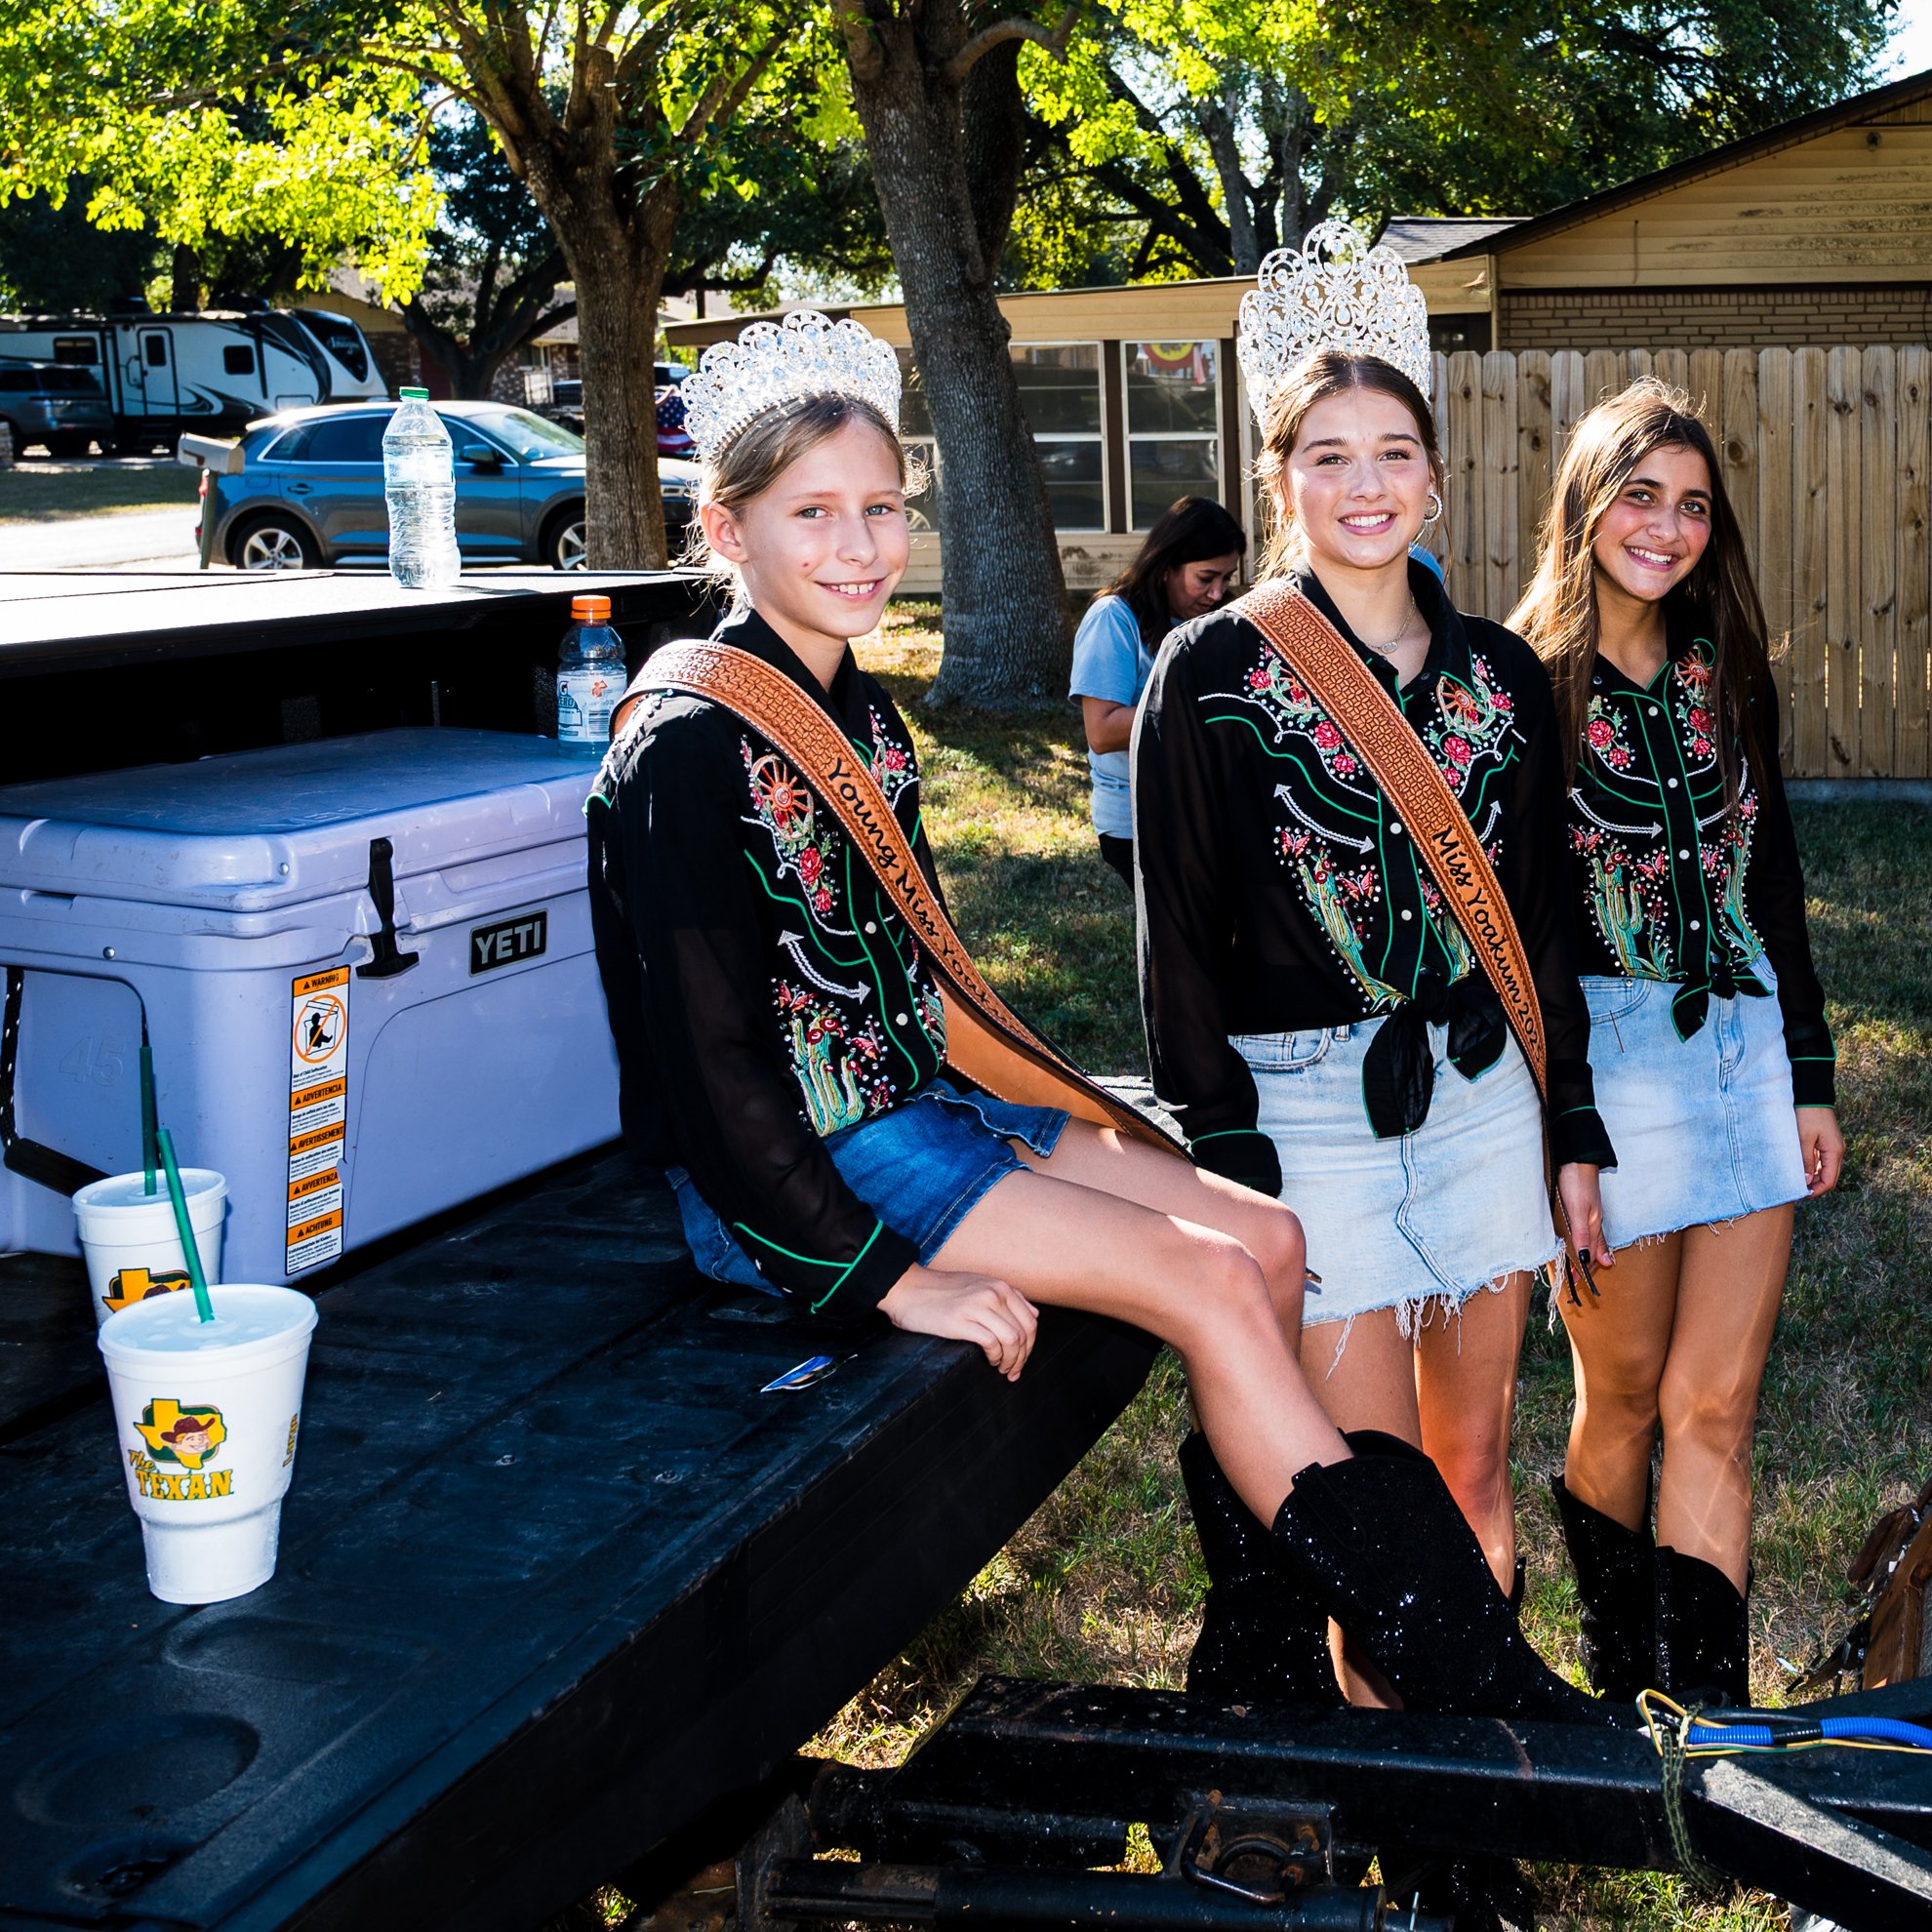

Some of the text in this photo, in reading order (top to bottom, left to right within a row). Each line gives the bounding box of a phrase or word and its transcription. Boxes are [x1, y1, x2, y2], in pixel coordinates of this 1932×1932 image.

[558, 697, 575, 707] ERO
[828, 758, 899, 869] Young
[895, 868, 940, 937] Miss
[1431, 825, 1474, 887] Miss
[1467, 887, 1522, 1003] Yoakum
[475, 920, 541, 965] YETI
[59, 1036, 127, 1087] 45
[302, 1083, 342, 1103] ADVERTENCIA
[299, 1125, 343, 1148] AVERTISSEMENT
[302, 1171, 339, 1191] AVVERTENZA
[304, 1217, 333, 1234] ACHTUNG
[128, 1449, 157, 1471] The
[136, 1469, 233, 1501] TEXAN
